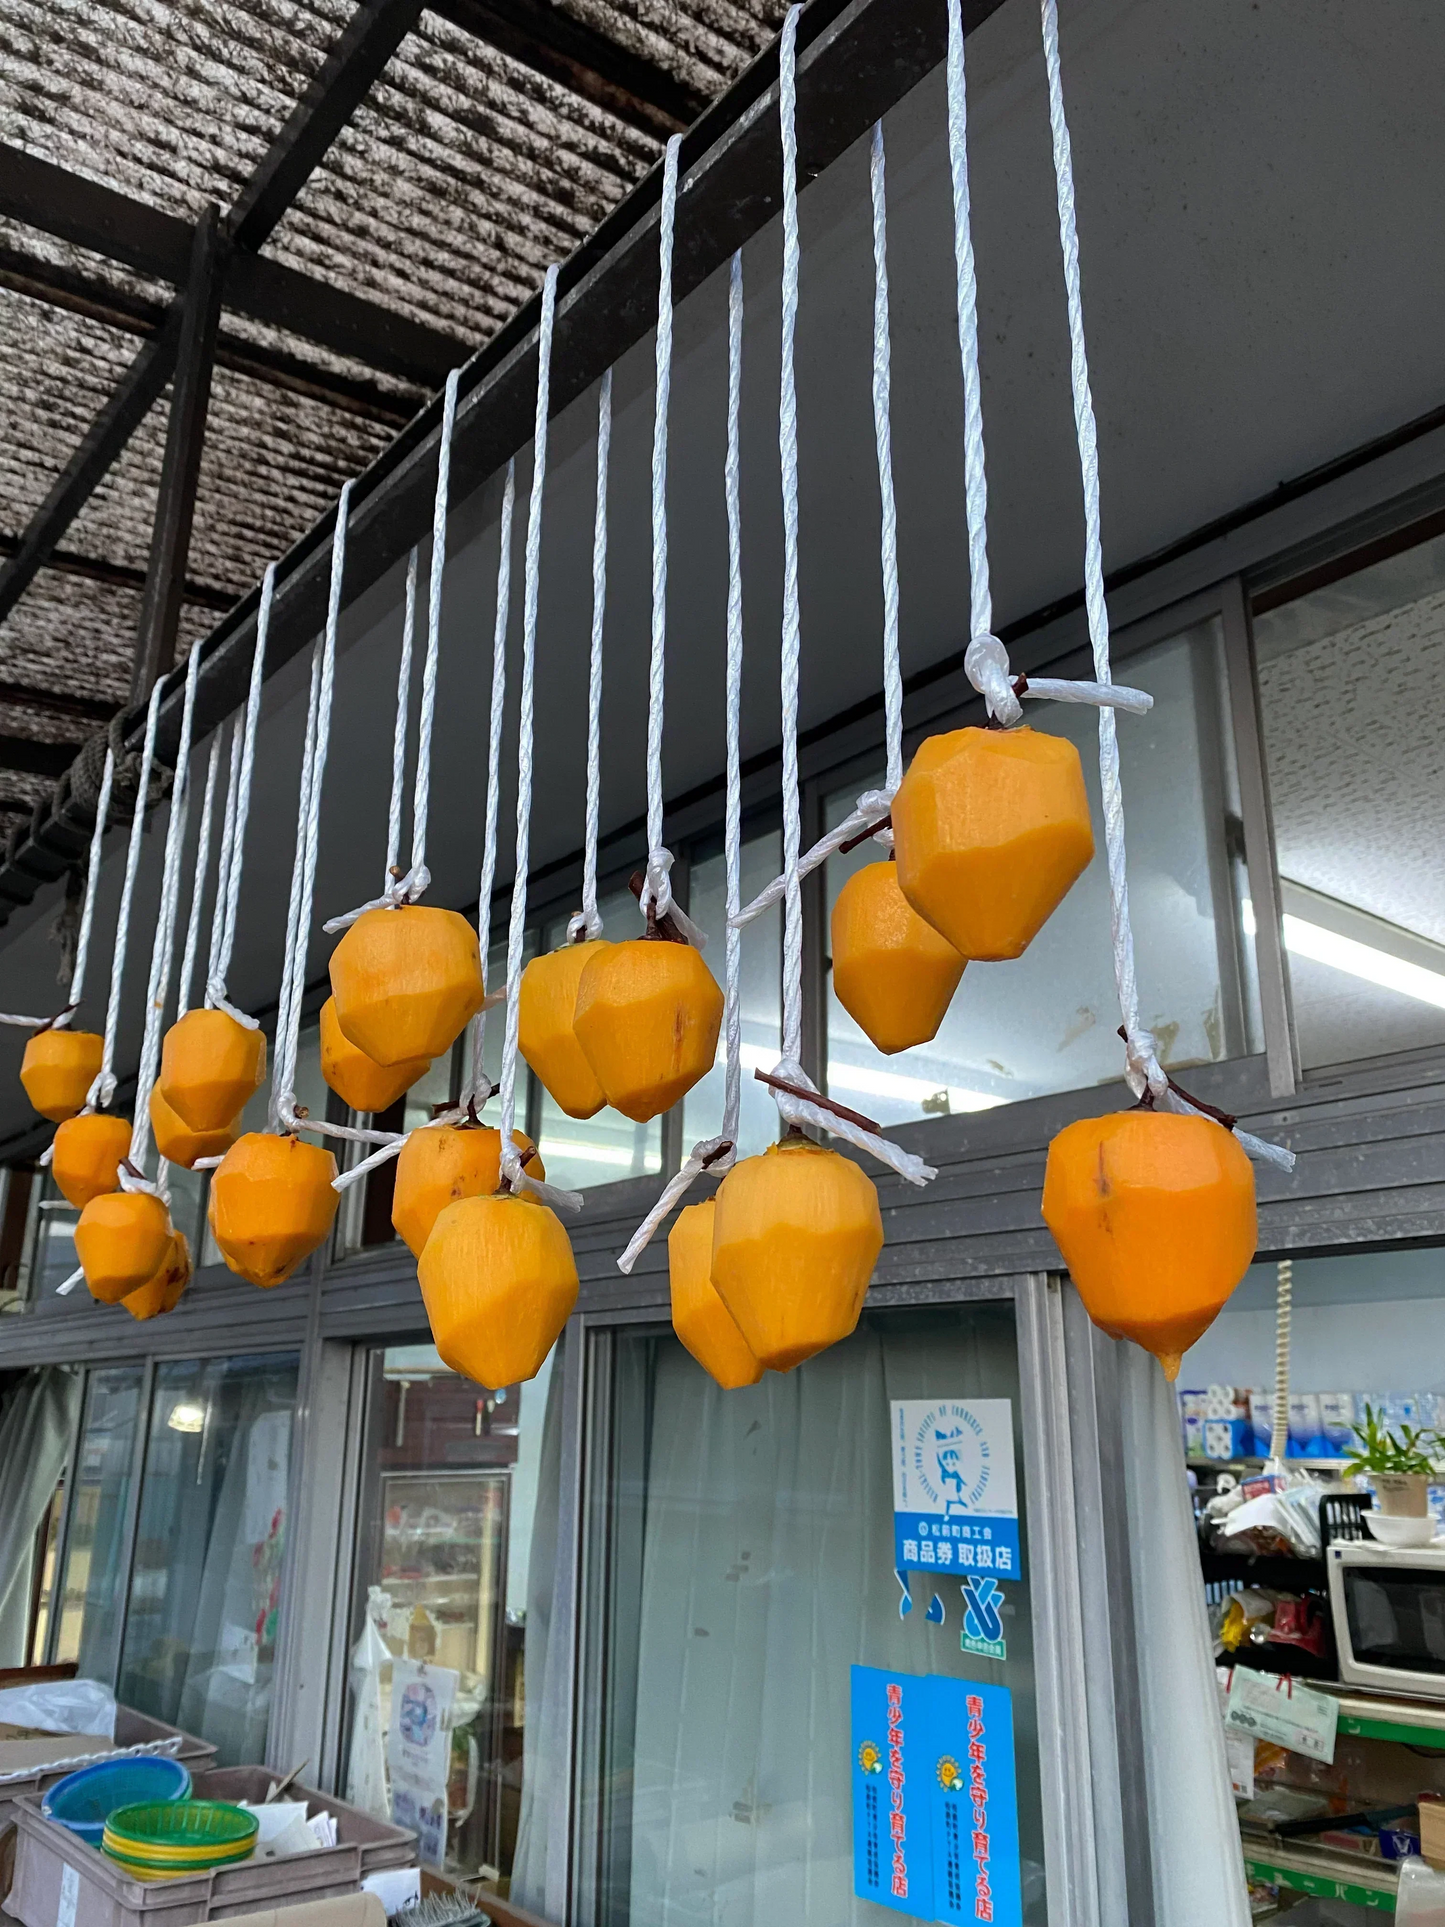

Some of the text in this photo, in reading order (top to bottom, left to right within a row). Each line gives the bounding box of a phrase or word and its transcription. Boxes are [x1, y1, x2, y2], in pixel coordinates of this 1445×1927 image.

[886, 1684, 909, 1899] 青少年を守り育てる店
[965, 1694, 994, 1923] 青少年を守り育てる店
